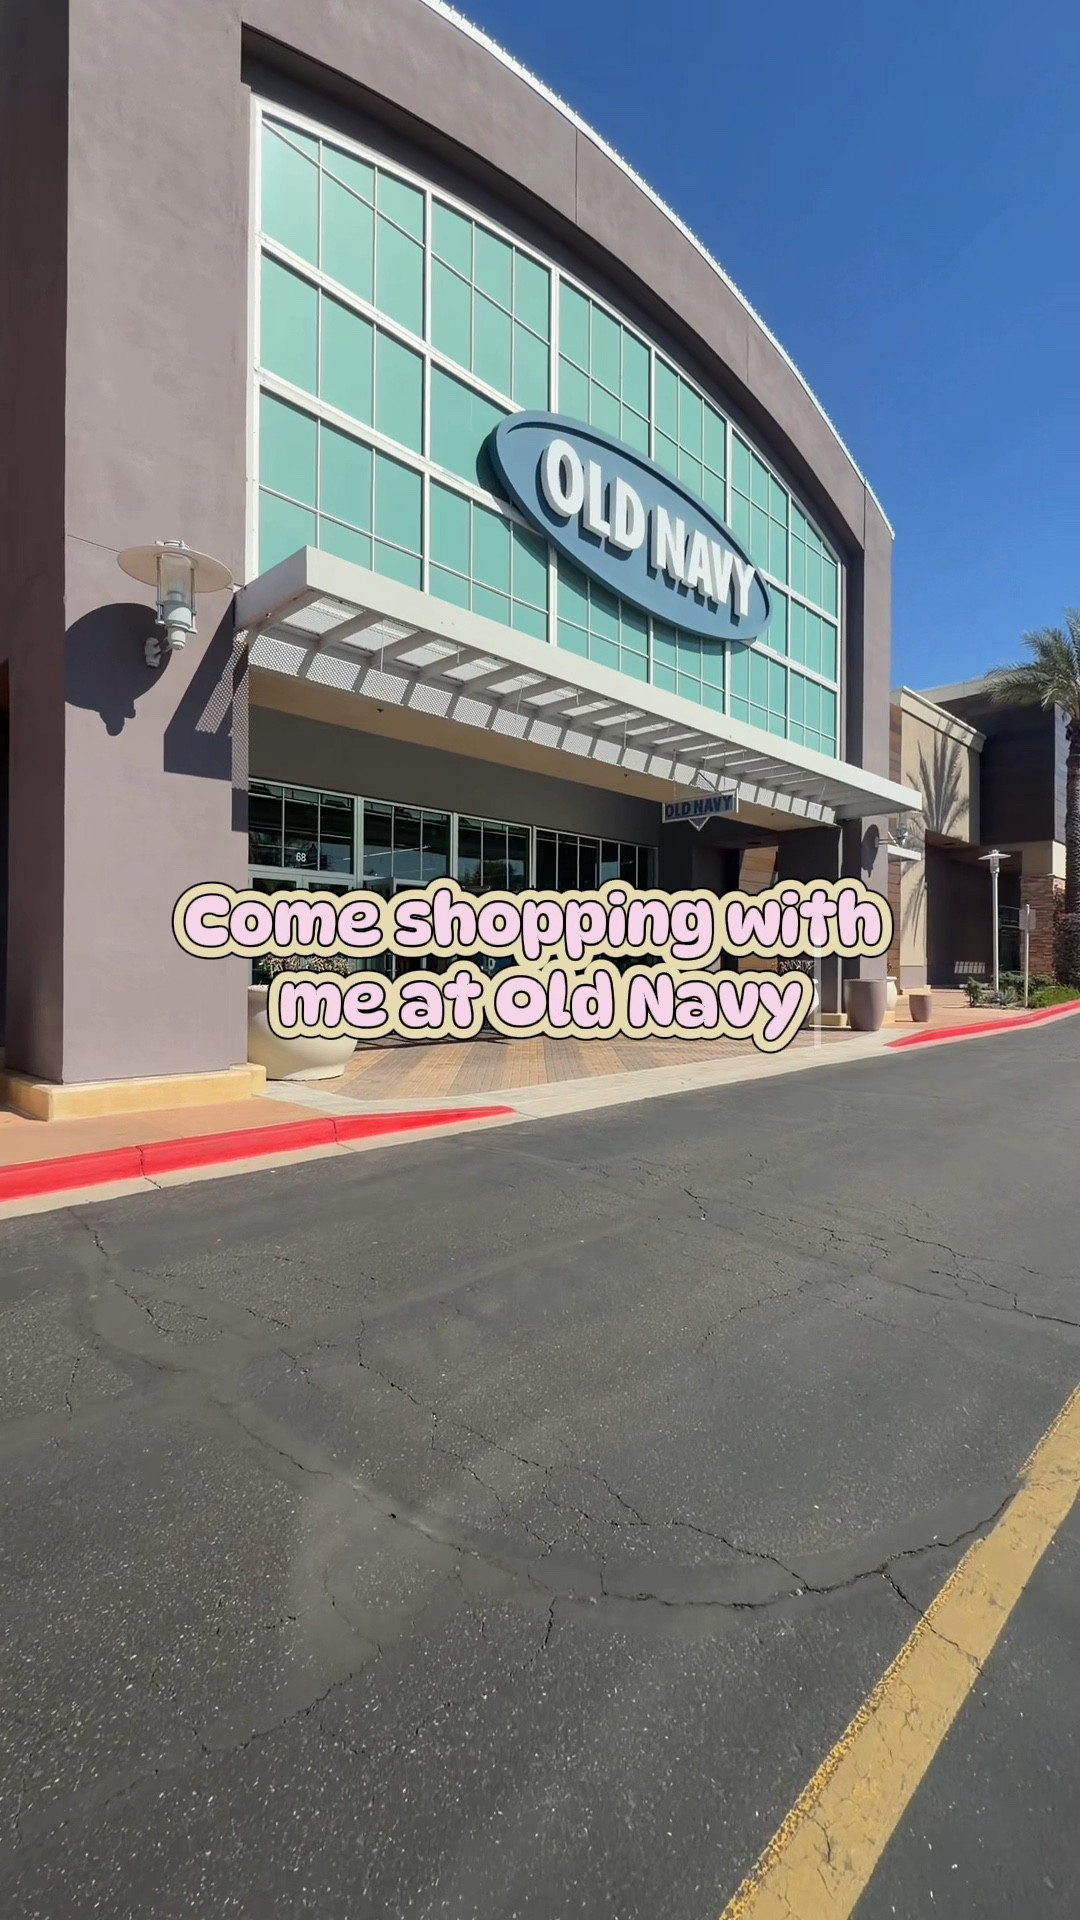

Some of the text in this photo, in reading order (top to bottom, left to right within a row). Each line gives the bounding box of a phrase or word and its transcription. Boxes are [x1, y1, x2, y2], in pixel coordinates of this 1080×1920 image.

[540, 438, 756, 617] OLD NAVY
[665, 795, 733, 818] OLD NAVY
[296, 852, 306, 862] 68
